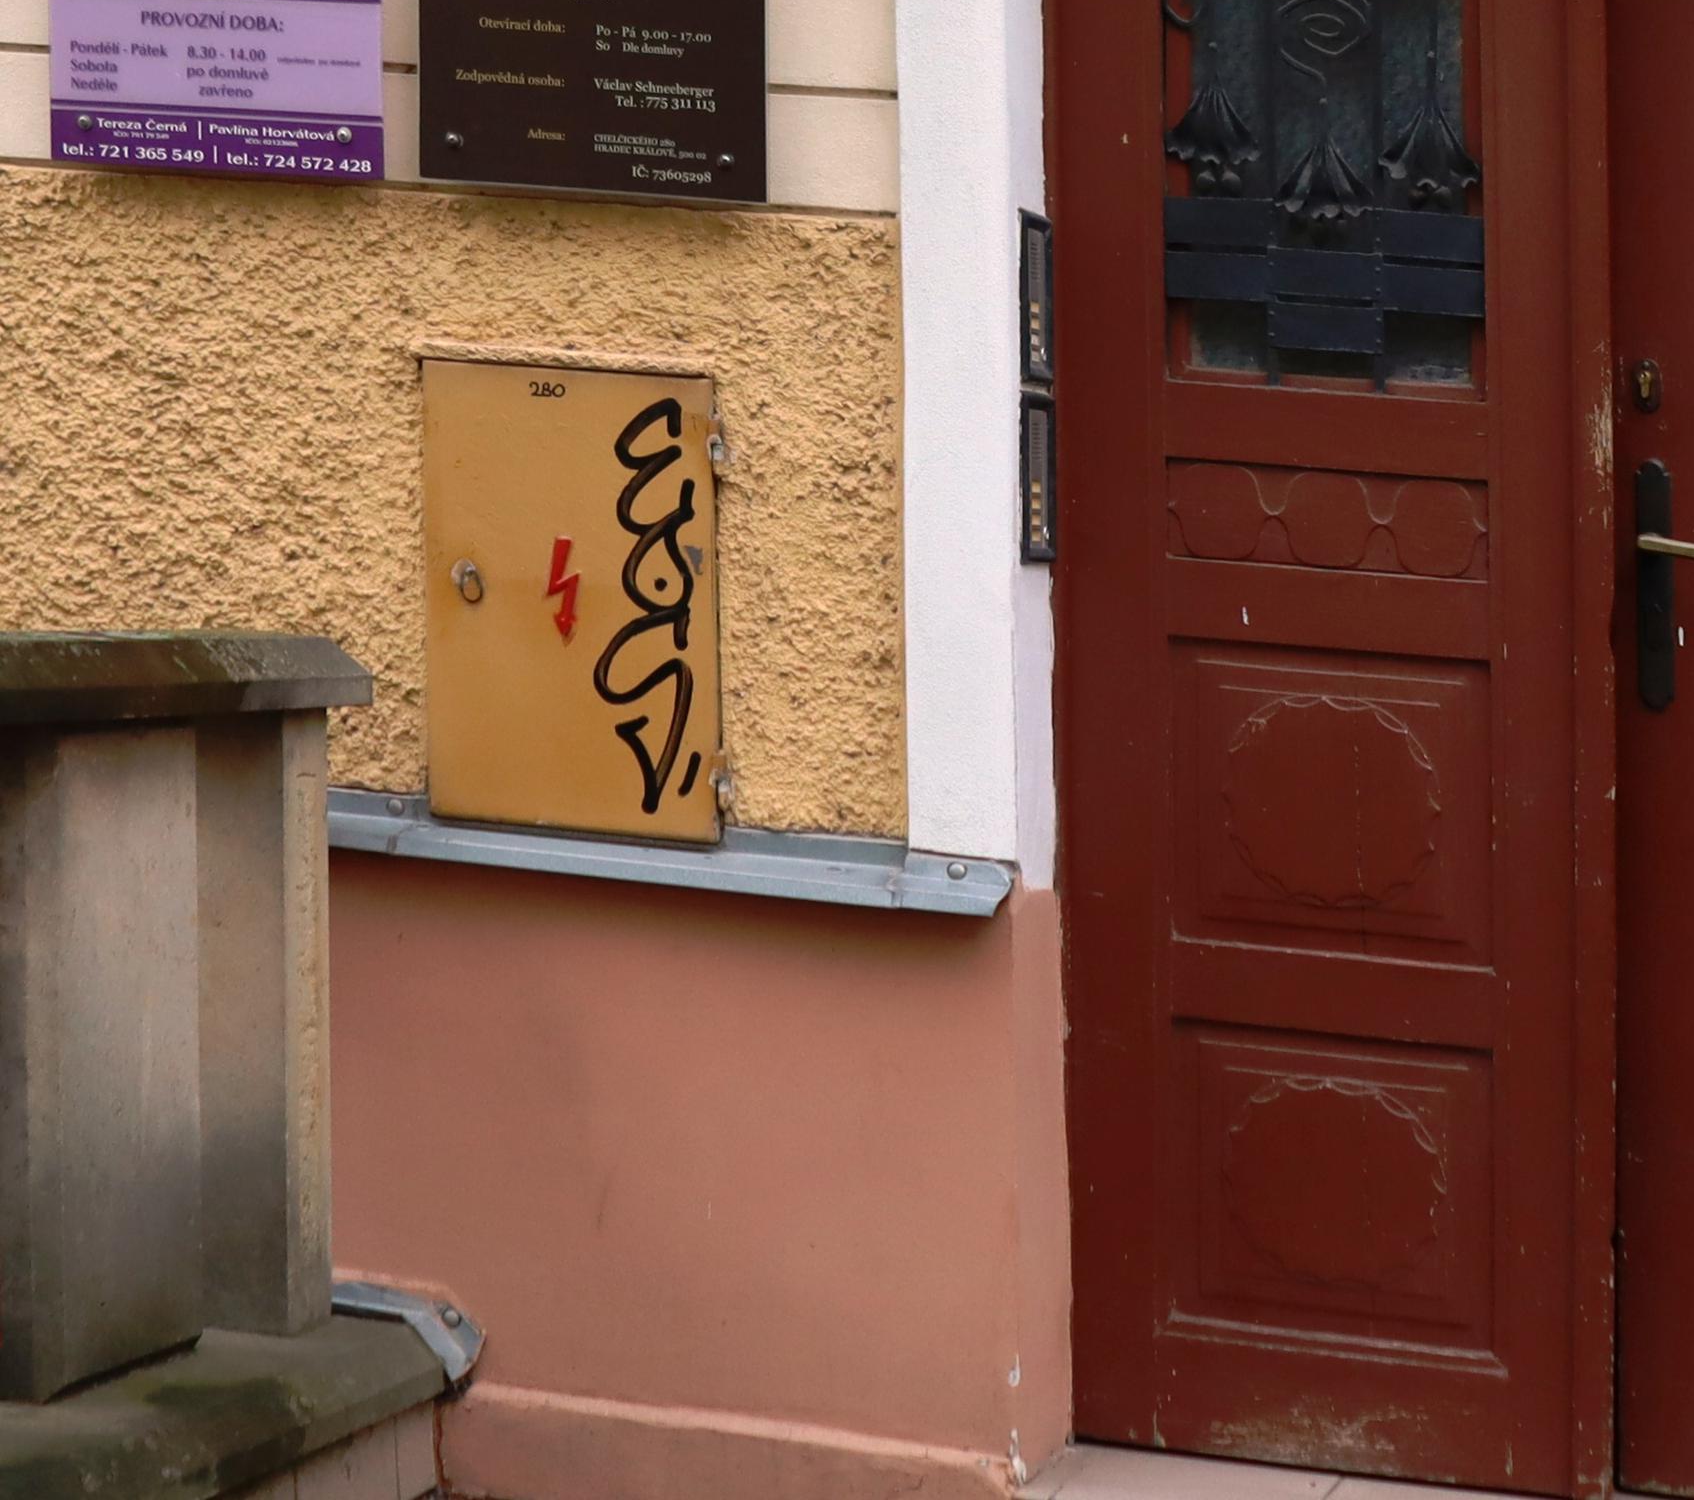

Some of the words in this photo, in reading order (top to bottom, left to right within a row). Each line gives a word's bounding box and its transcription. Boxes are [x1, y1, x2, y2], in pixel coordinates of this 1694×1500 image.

[140, 11, 225, 29] PROVOZNÍ
[229, 15, 284, 32] DOBA:
[479, 16, 531, 31] Otevírací
[533, 19, 566, 33] doba:
[595, 24, 611, 36] Po
[622, 25, 637, 39] Pá
[641, 29, 669, 41] 9.00
[680, 32, 712, 43] 17.00
[70, 40, 120, 55] Pondělí
[131, 42, 168, 57] Pátek
[187, 45, 216, 59] 8.30
[230, 47, 266, 62] 14.00
[595, 39, 611, 51] So
[622, 41, 640, 53] Dle
[641, 43, 685, 58] domluvy
[70, 59, 118, 74] Sobota
[186, 66, 205, 79] po
[208, 66, 269, 80] domluvě
[455, 68, 525, 85] Zodpovědná
[528, 74, 566, 87] osoba:
[70, 76, 118, 91] Neděle
[199, 84, 253, 98] zavřeno
[594, 77, 633, 91] Václav
[634, 81, 714, 99] Schneeberger
[671, 98, 692, 111] 311
[695, 100, 717, 113] 113
[96, 117, 142, 130] Tereza
[145, 117, 188, 133] Černá
[209, 123, 259, 137] Pavlína
[262, 126, 336, 142] Horvátová
[527, 128, 566, 141] Adresa:
[62, 142, 94, 156] tel.:
[99, 144, 129, 159] 721
[135, 146, 168, 161] 365
[171, 148, 205, 163] 549
[227, 152, 258, 167] tel.:
[264, 154, 296, 169] 724
[301, 156, 334, 171] 572
[339, 159, 372, 173] 428
[631, 164, 649, 179] IČ:
[652, 169, 712, 184] 73605298
[529, 381, 566, 399] 280
